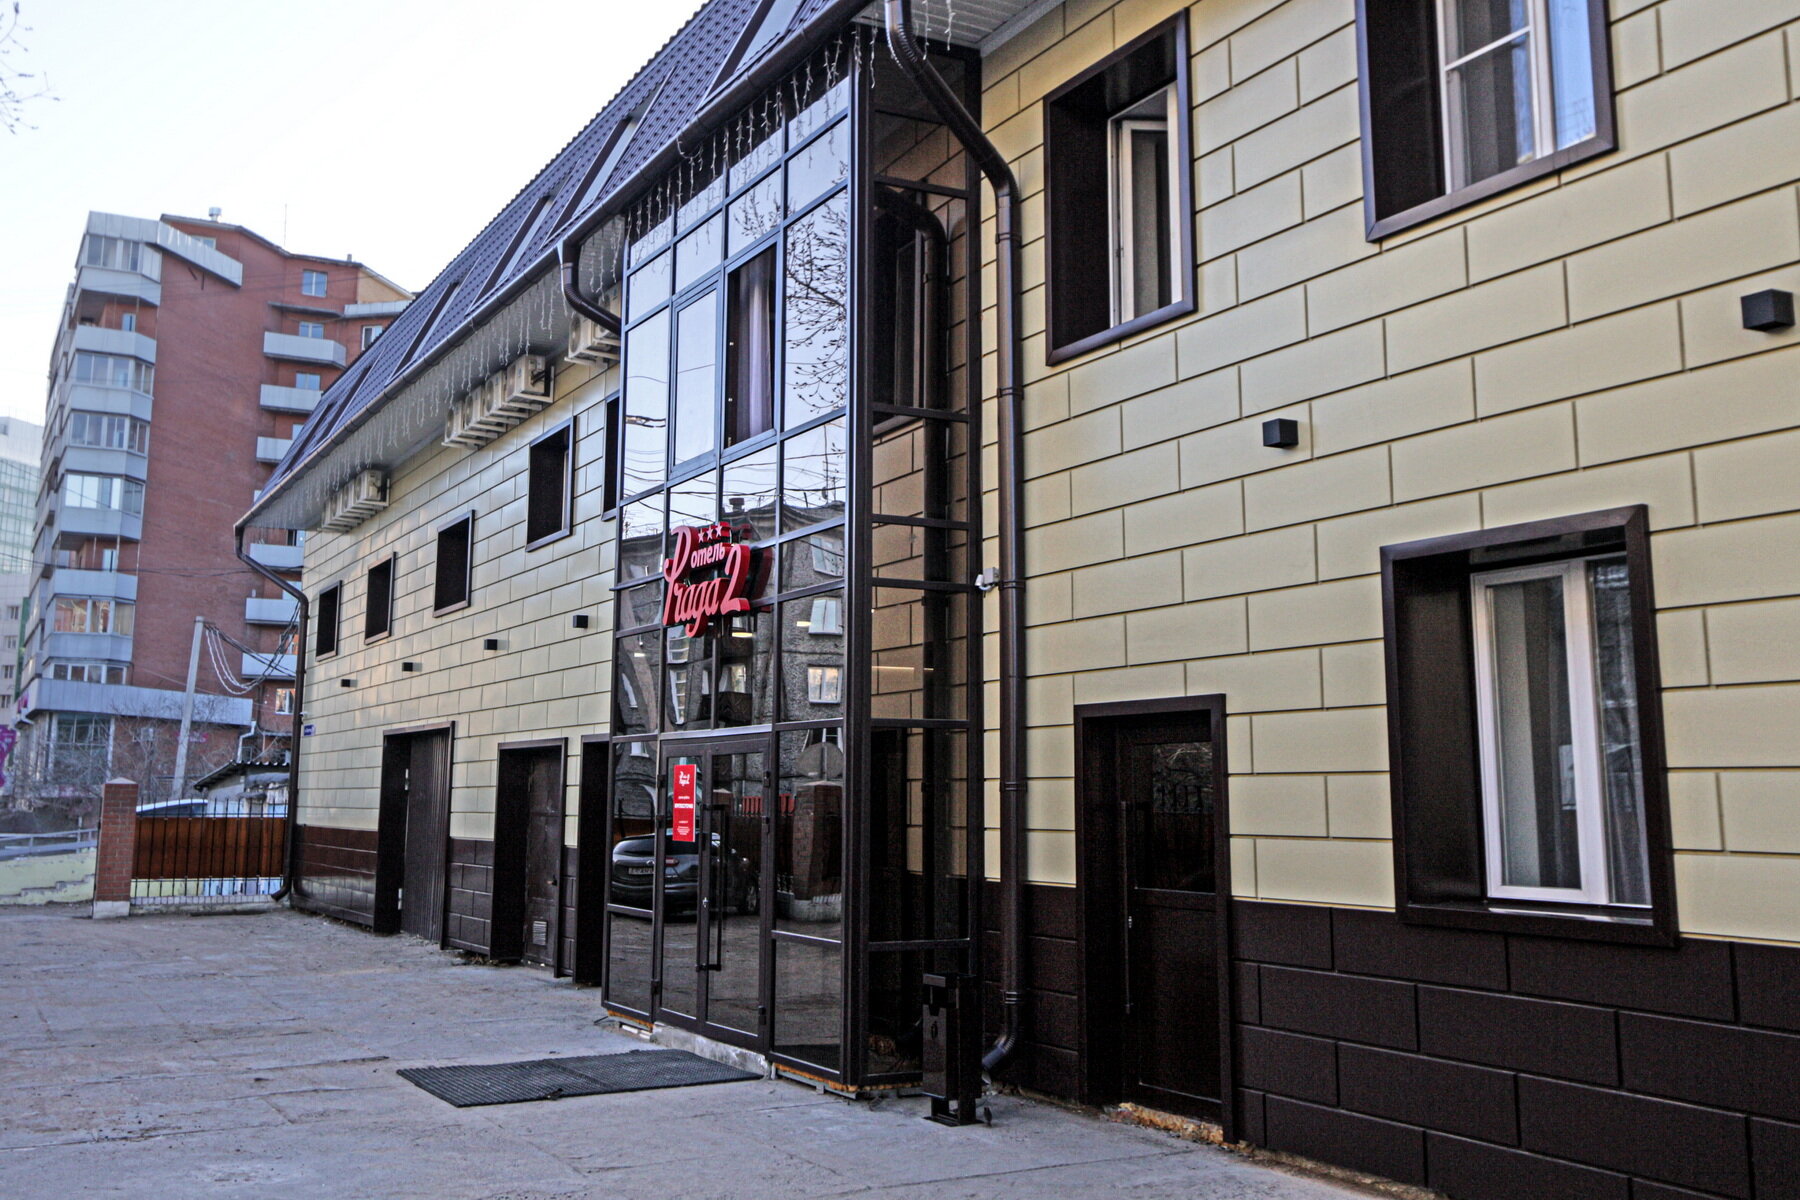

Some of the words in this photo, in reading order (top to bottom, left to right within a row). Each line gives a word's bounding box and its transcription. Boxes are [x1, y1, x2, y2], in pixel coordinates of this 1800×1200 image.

[663, 526, 720, 637] Praga
[720, 544, 746, 615] 2
[691, 542, 725, 568] отель
